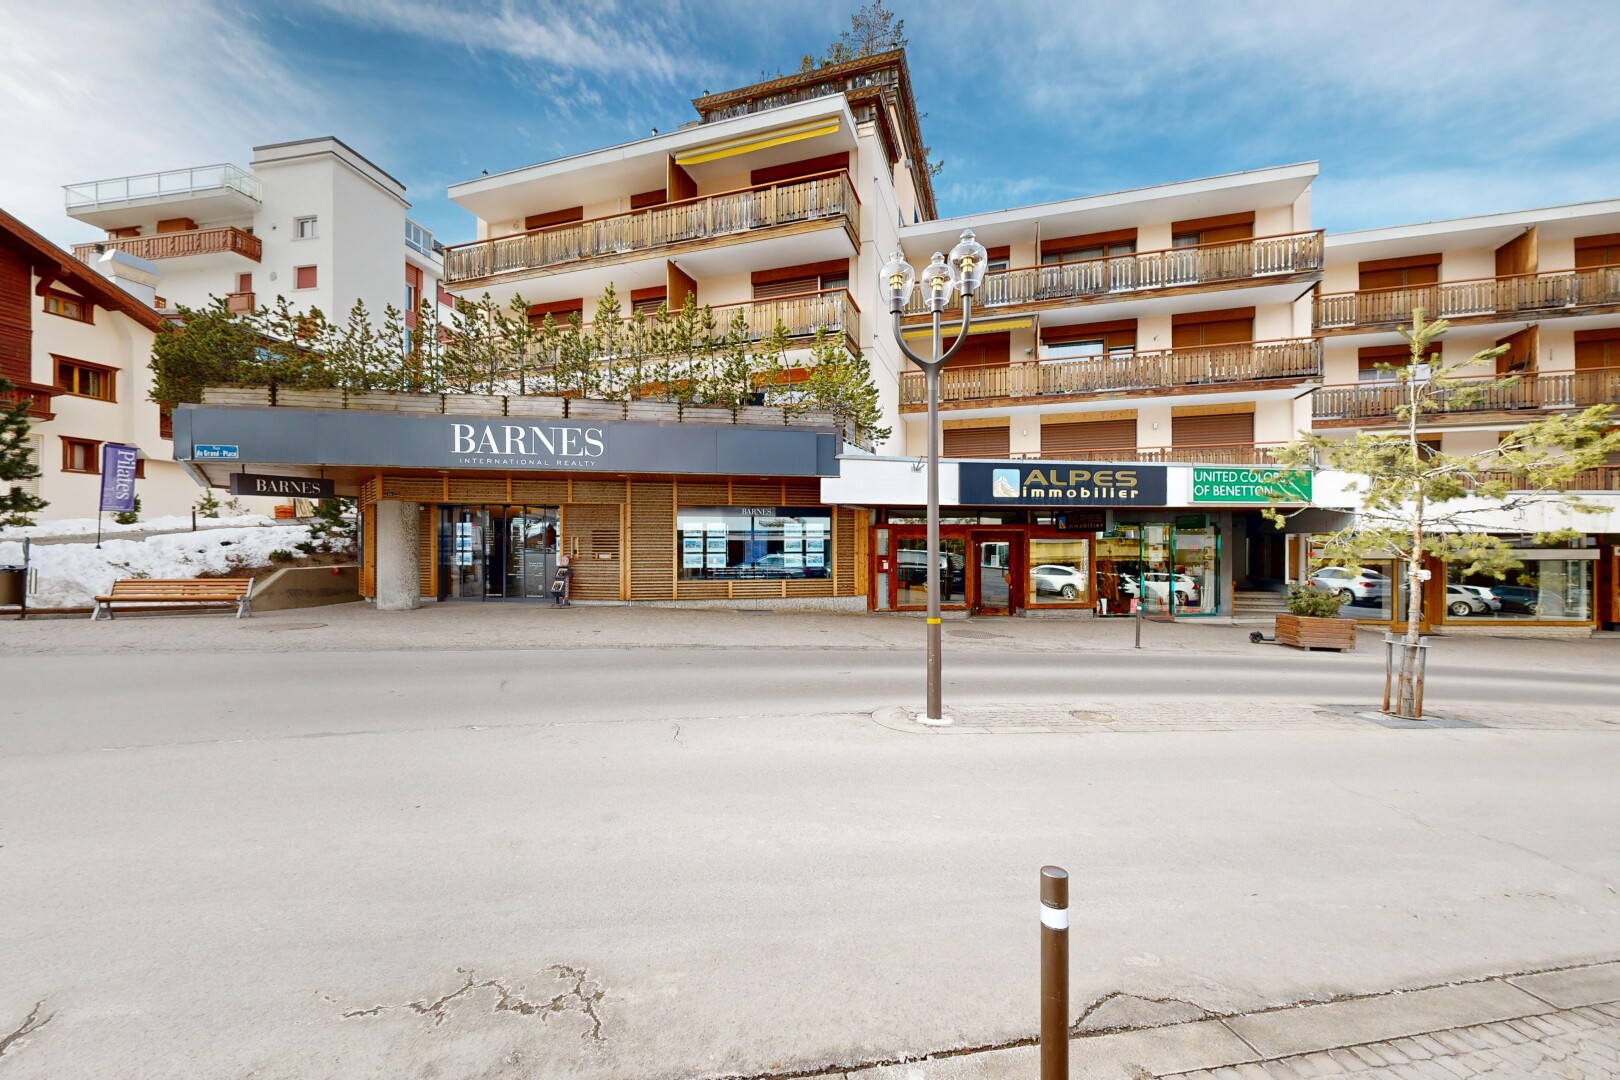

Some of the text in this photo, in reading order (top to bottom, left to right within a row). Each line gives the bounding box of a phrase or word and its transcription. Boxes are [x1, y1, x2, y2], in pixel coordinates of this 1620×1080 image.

[450, 423, 604, 458] BARNES
[459, 457, 596, 467] INTERNATIONAL REALTY
[115, 449, 136, 500] Pilates
[1023, 469, 1138, 487] ALPES
[1194, 471, 1238, 482] UNITED
[256, 479, 320, 494] BARNES
[1022, 486, 1139, 499] immobilier
[1194, 485, 1273, 497] OF BENETTON
